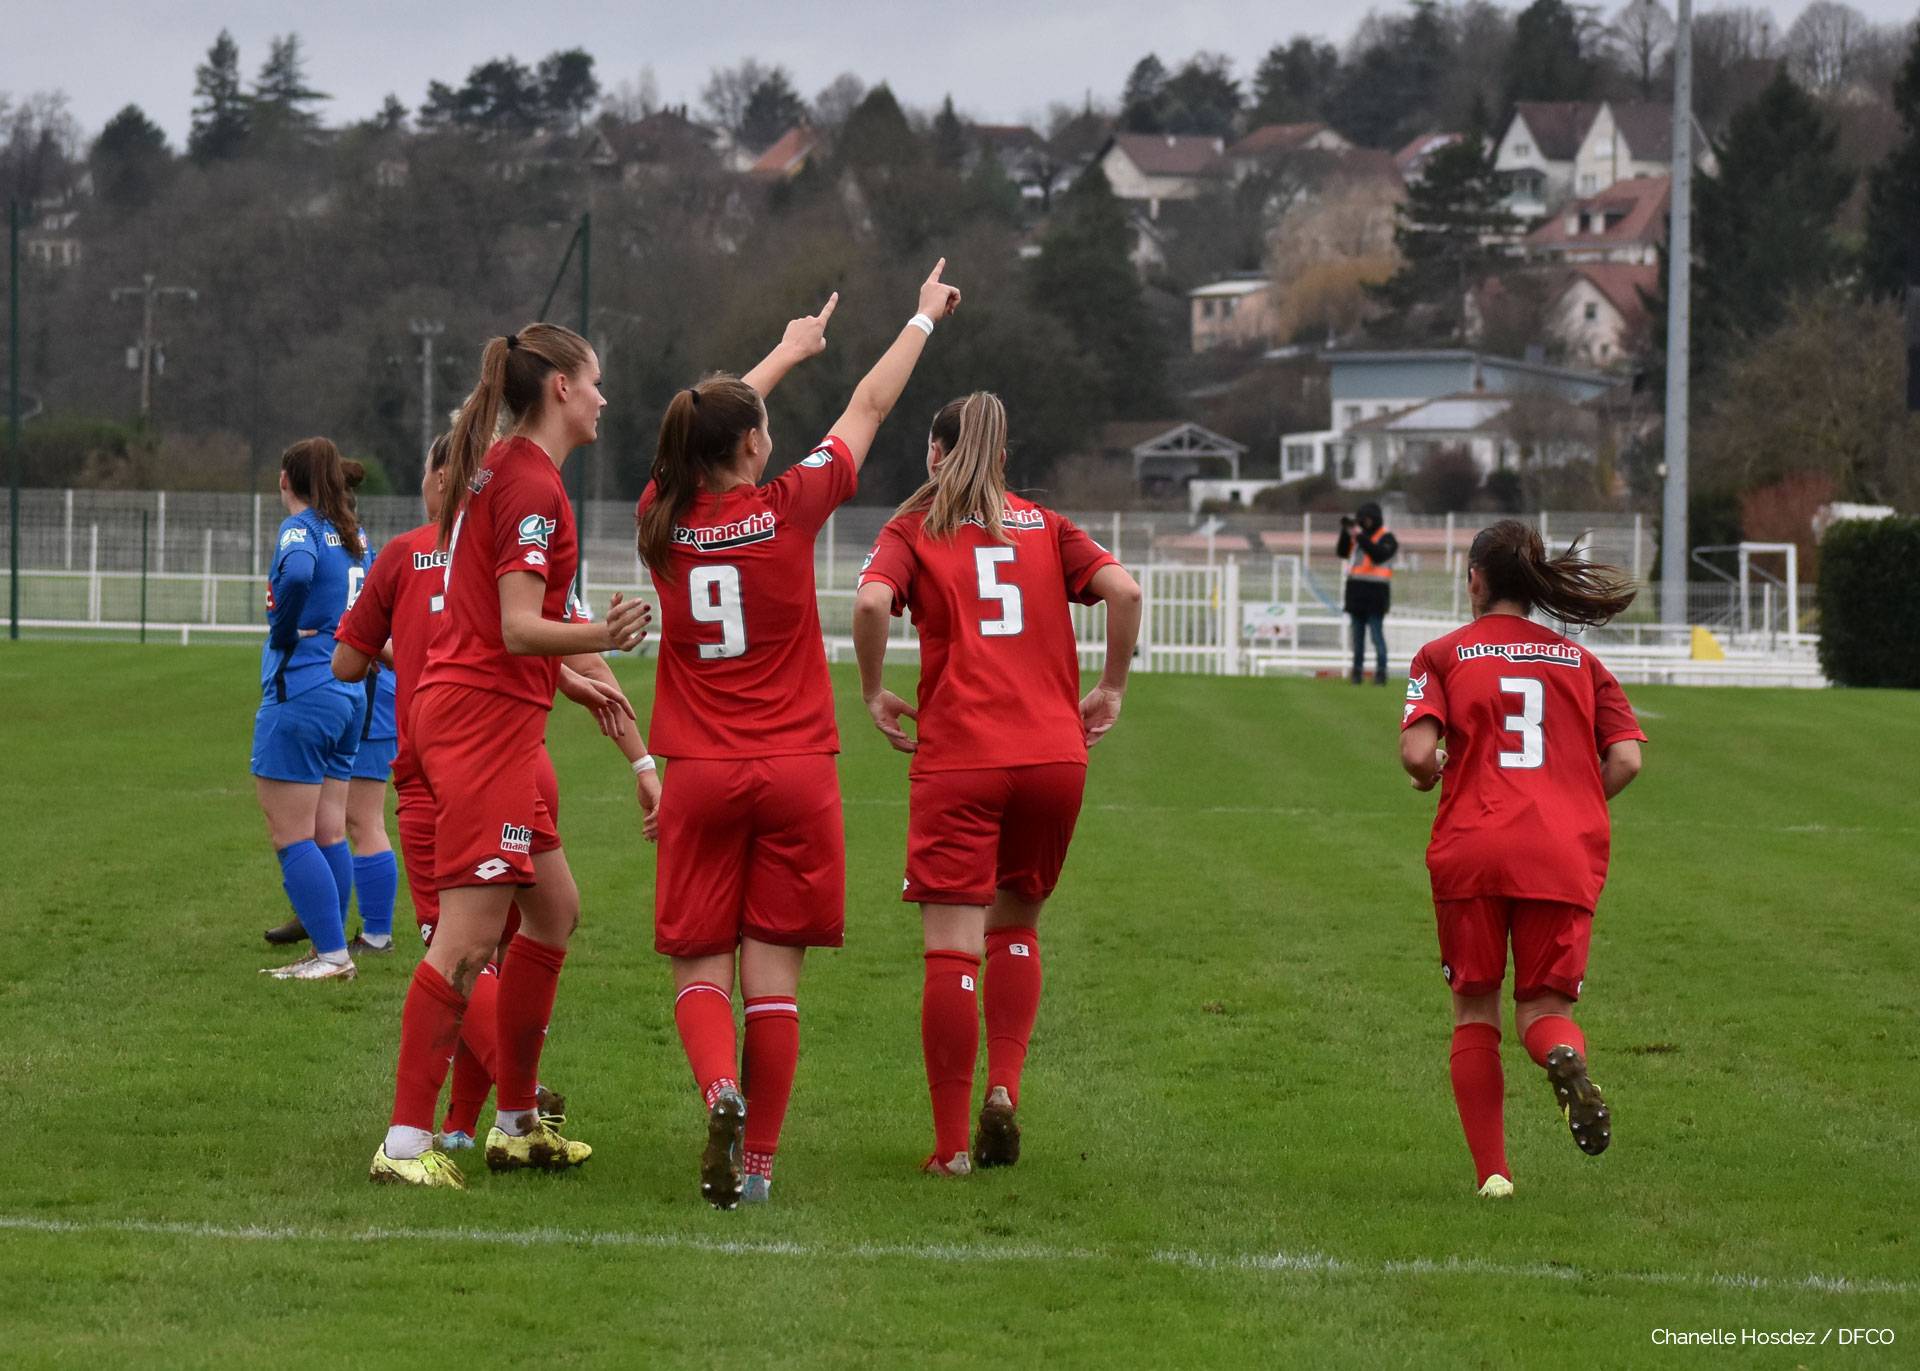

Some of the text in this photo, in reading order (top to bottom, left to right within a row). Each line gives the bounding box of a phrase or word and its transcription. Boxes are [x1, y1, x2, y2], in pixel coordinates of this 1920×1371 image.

[689, 564, 748, 660] 9
[974, 546, 1023, 636] 5
[1499, 677, 1544, 768] 3
